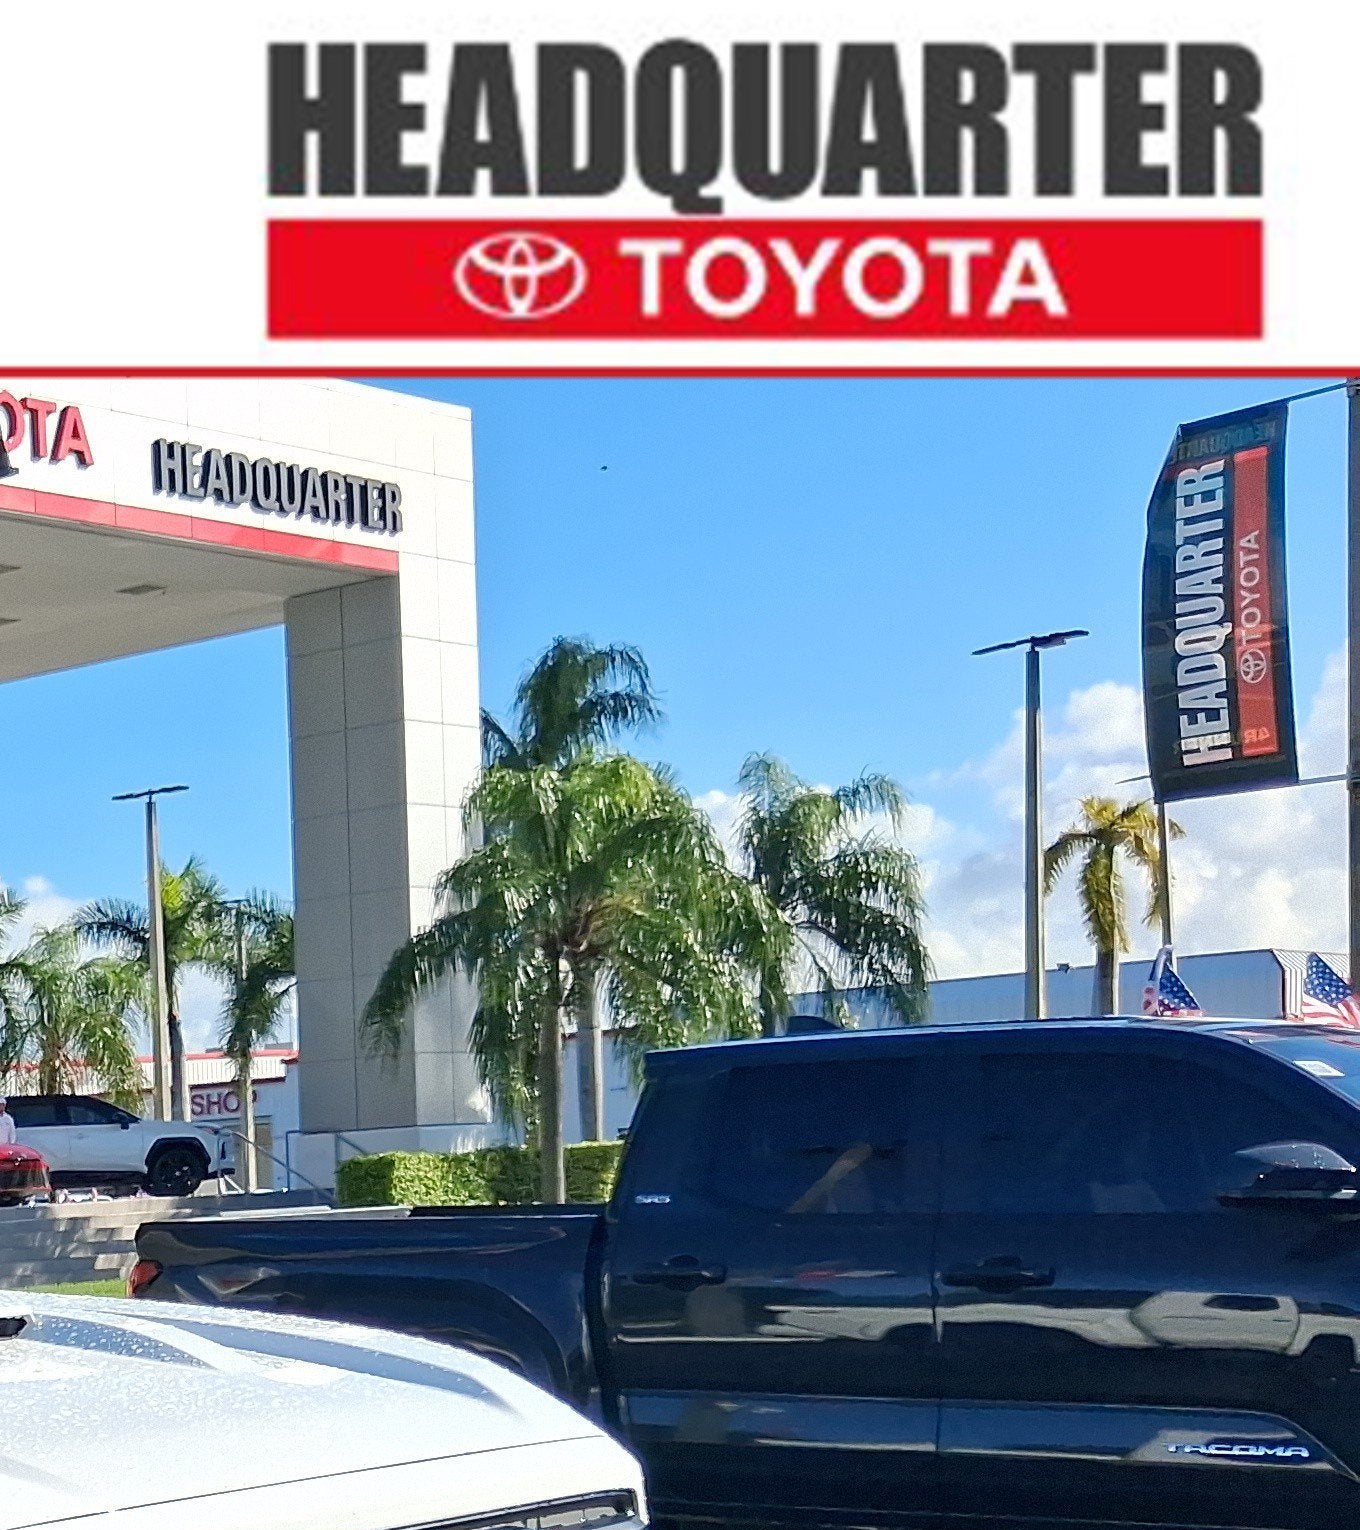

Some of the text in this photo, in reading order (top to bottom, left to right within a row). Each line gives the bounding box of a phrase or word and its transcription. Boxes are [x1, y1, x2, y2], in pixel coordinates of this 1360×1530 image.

[151, 437, 403, 536] HEADQUARTER
[1174, 458, 1235, 767] HEADQUARTER
[1238, 529, 1264, 648] TOYOTA
[1163, 1442, 1310, 1458] TACOMA
